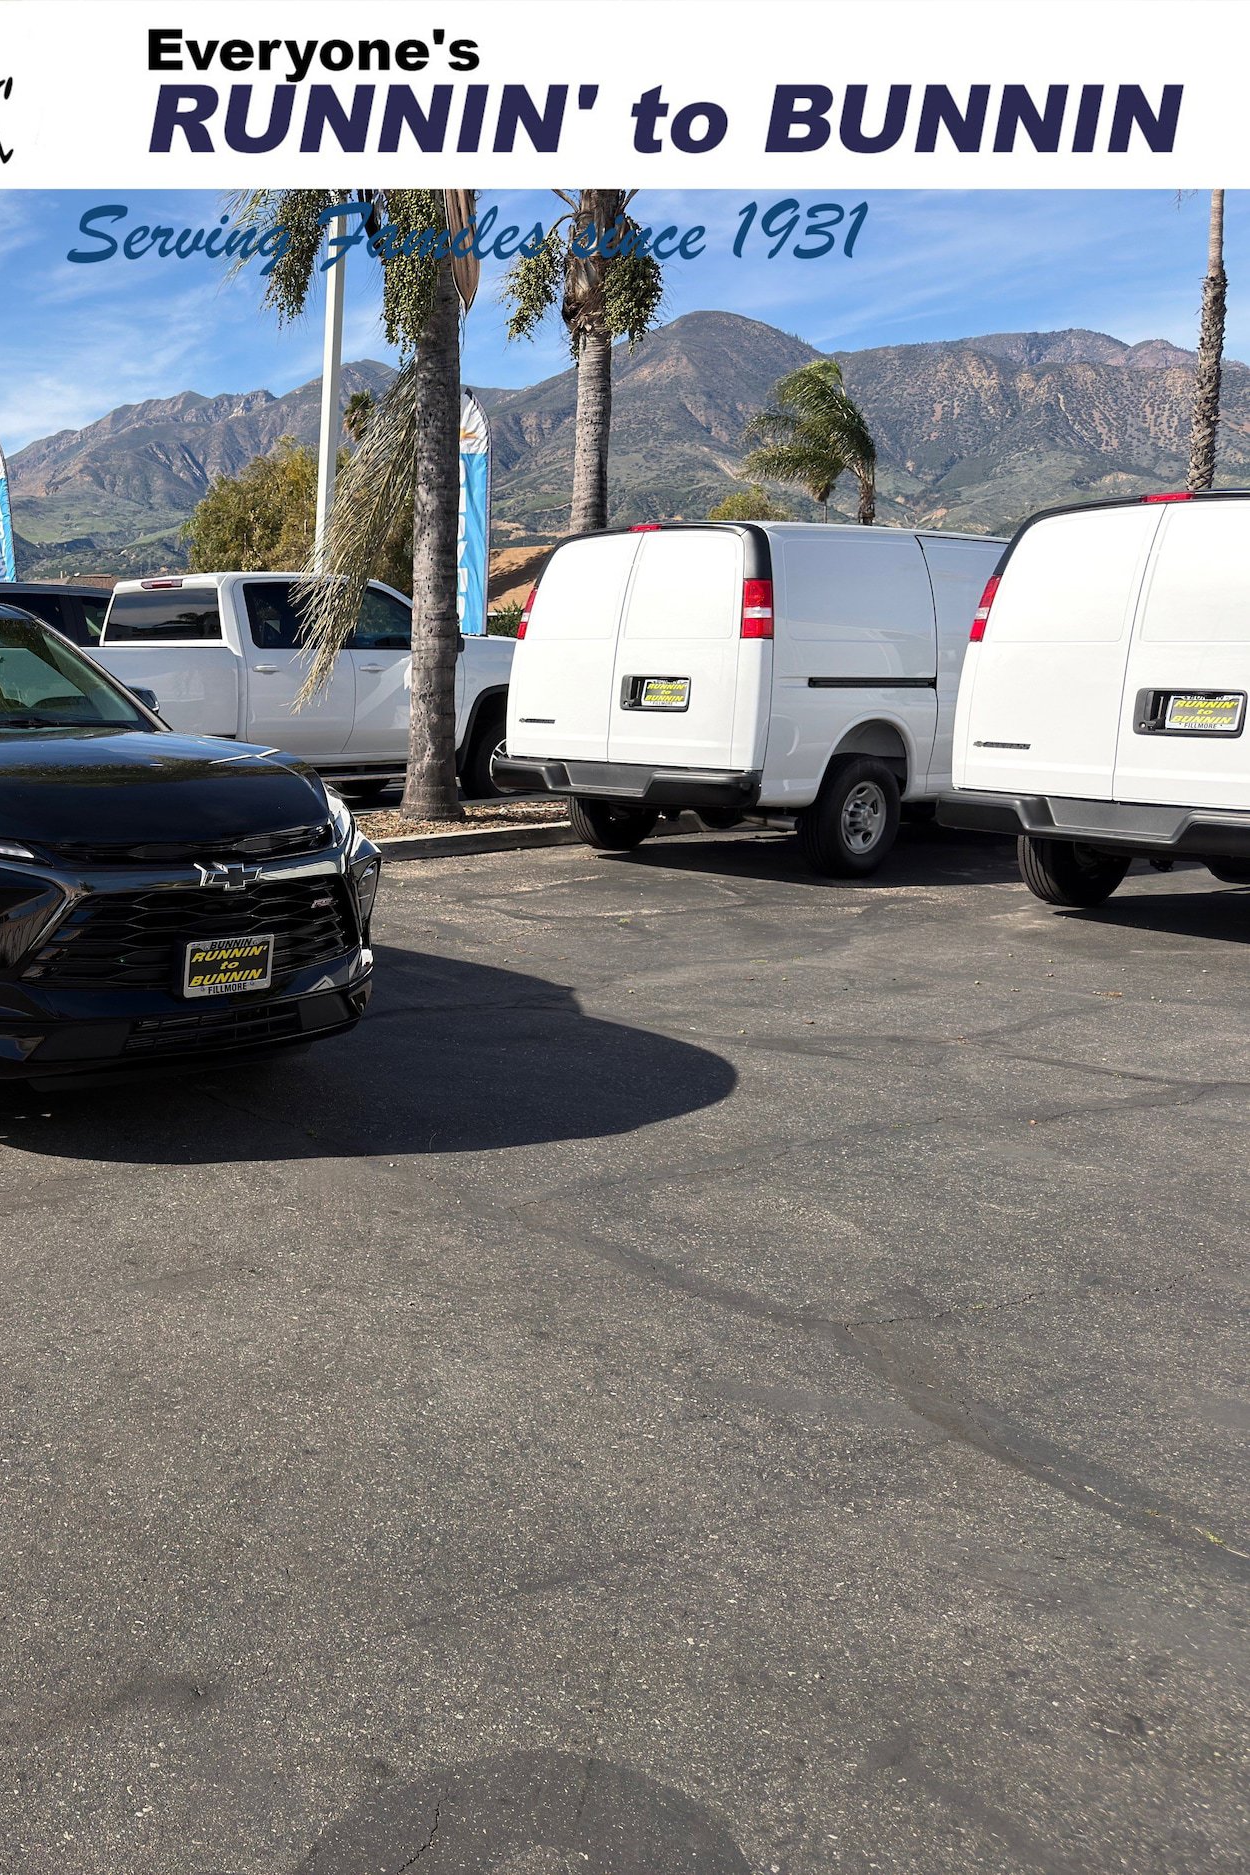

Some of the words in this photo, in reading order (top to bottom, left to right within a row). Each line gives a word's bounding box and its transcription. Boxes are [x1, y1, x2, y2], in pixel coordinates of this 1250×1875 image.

[1170, 715, 1233, 724] BUNNIN
[210, 938, 253, 950] BUNNIN
[191, 945, 268, 963] RUNNIN'
[220, 961, 240, 970] to
[189, 968, 263, 987] BUNNIN
[208, 982, 247, 994] FILLMORE
